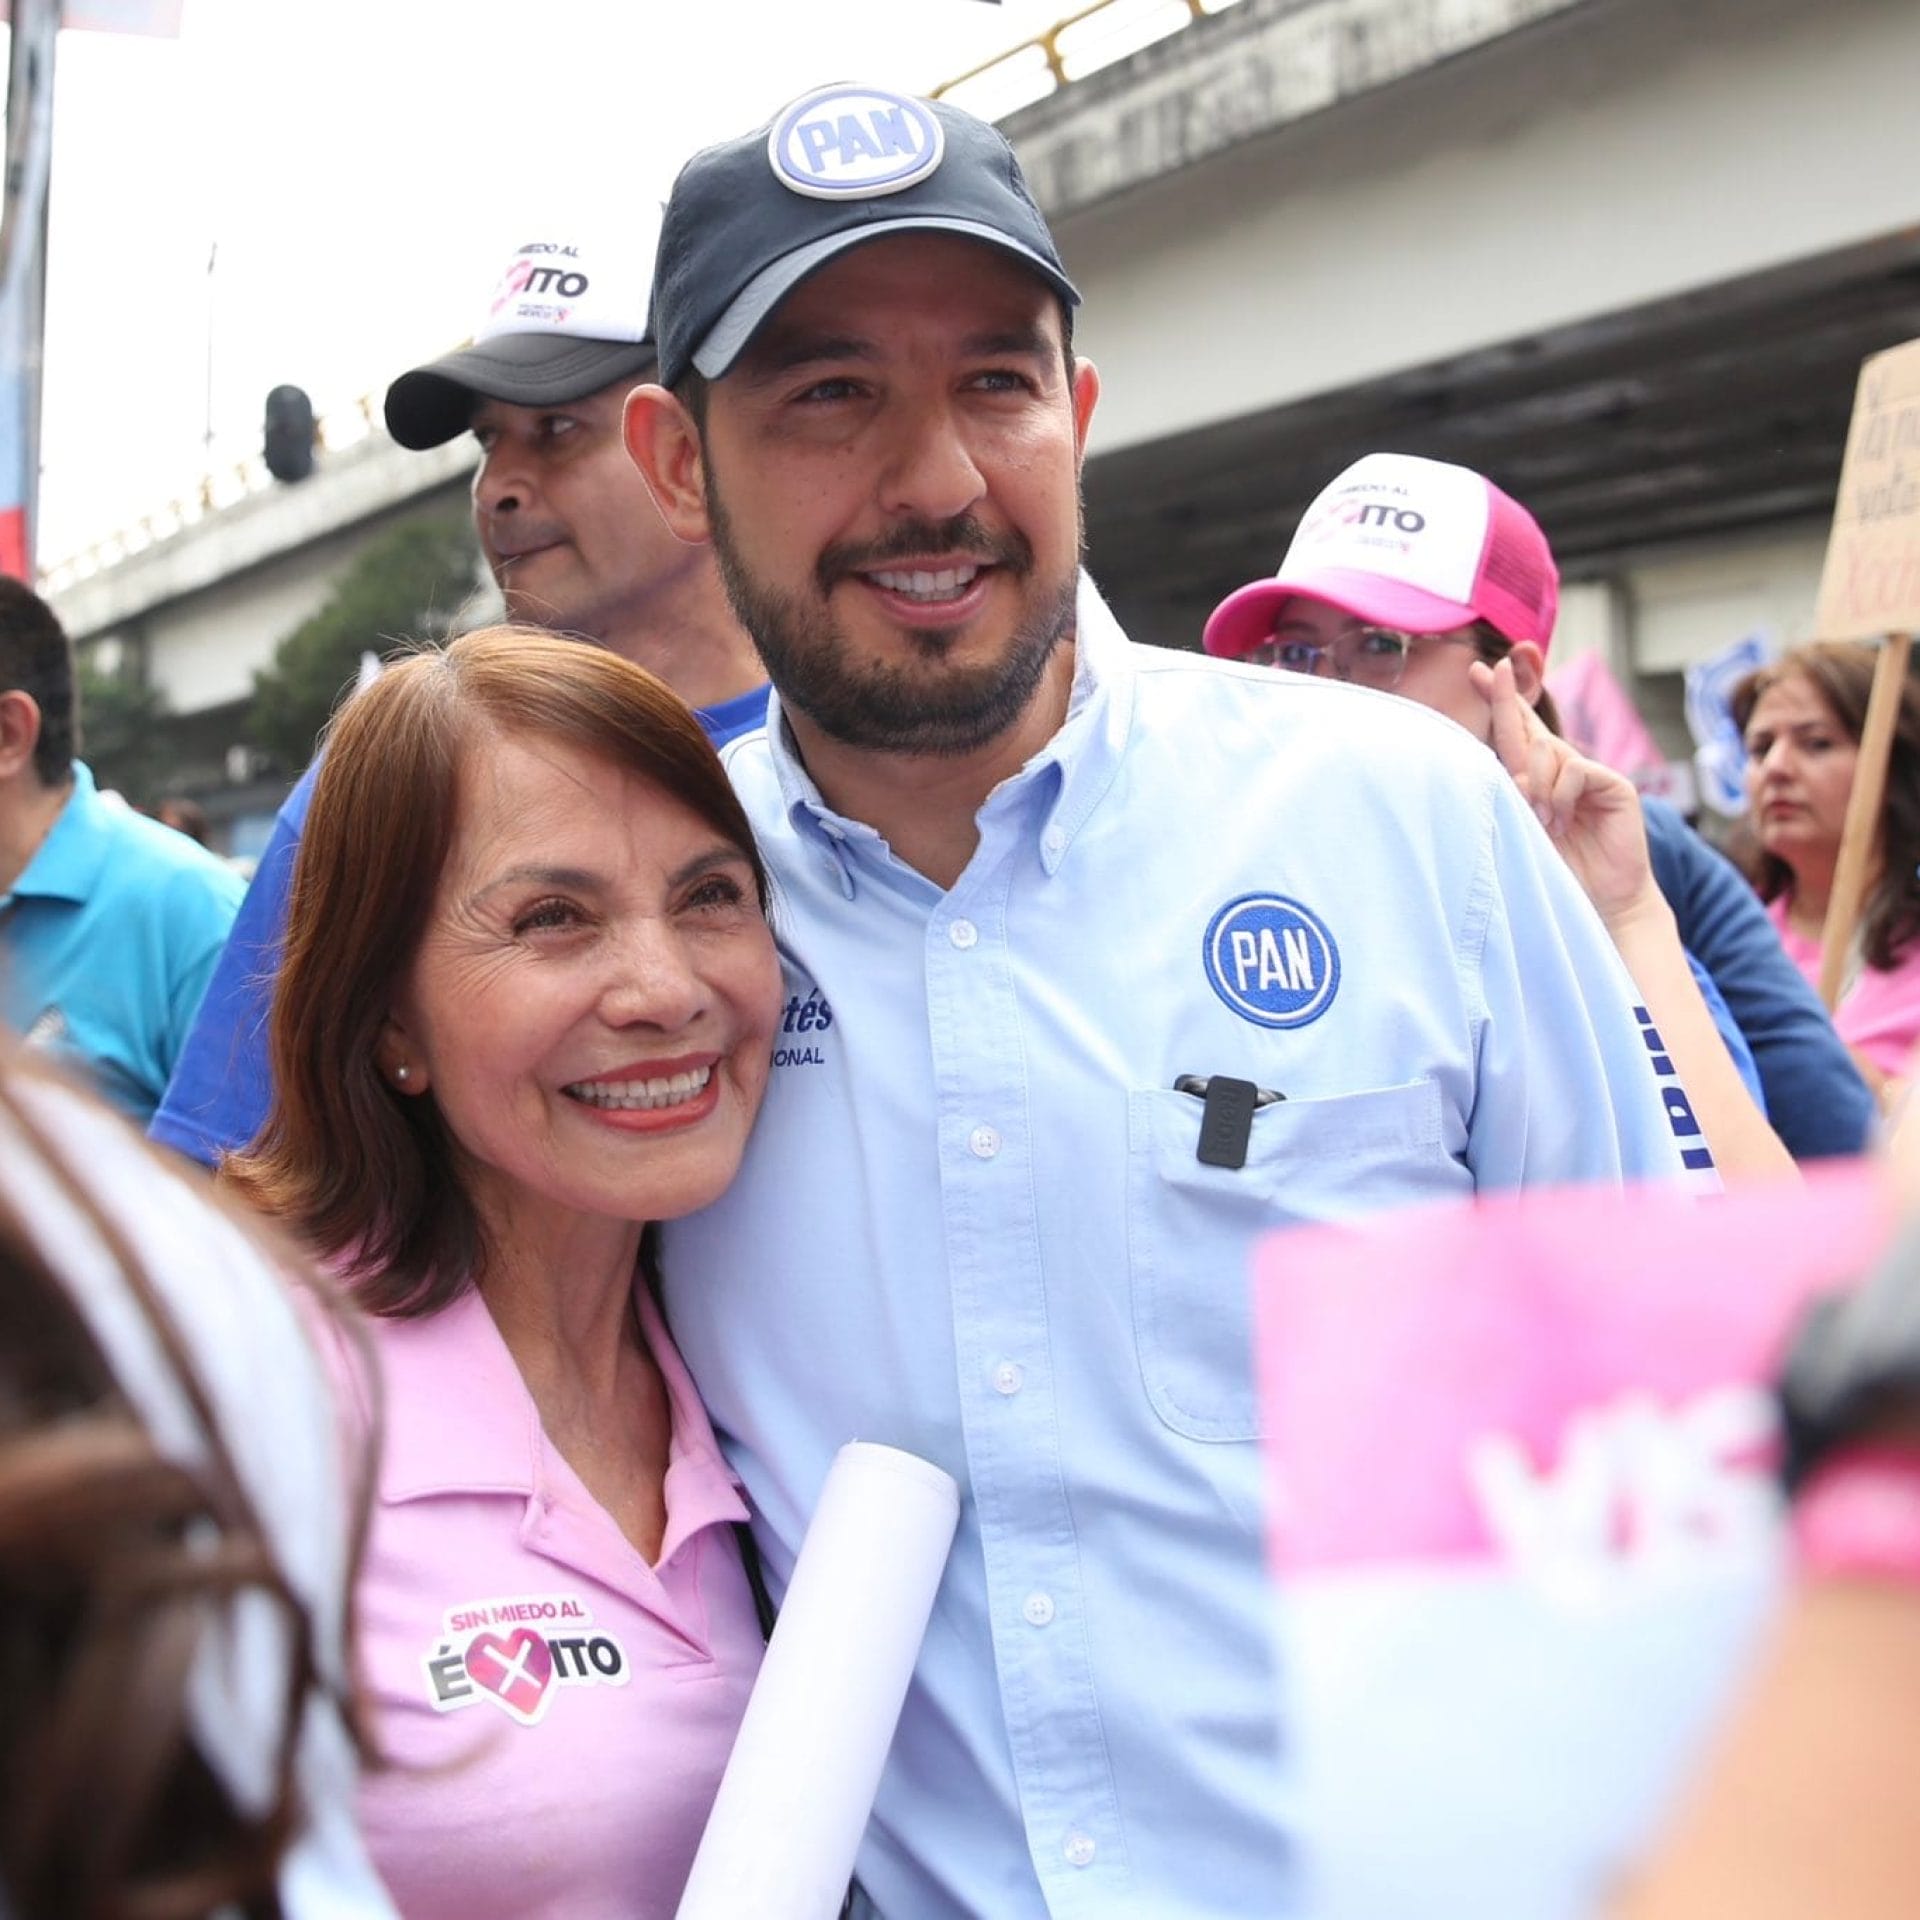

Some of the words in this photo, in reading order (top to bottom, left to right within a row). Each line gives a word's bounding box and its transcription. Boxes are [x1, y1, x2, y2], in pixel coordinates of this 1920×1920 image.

[796, 106, 918, 174] PAN
[1230, 927, 1317, 991] PAN
[781, 987, 833, 1034] tés
[450, 1609, 489, 1632] SIN
[494, 1602, 557, 1624] MIEDO
[561, 1600, 585, 1618] AL
